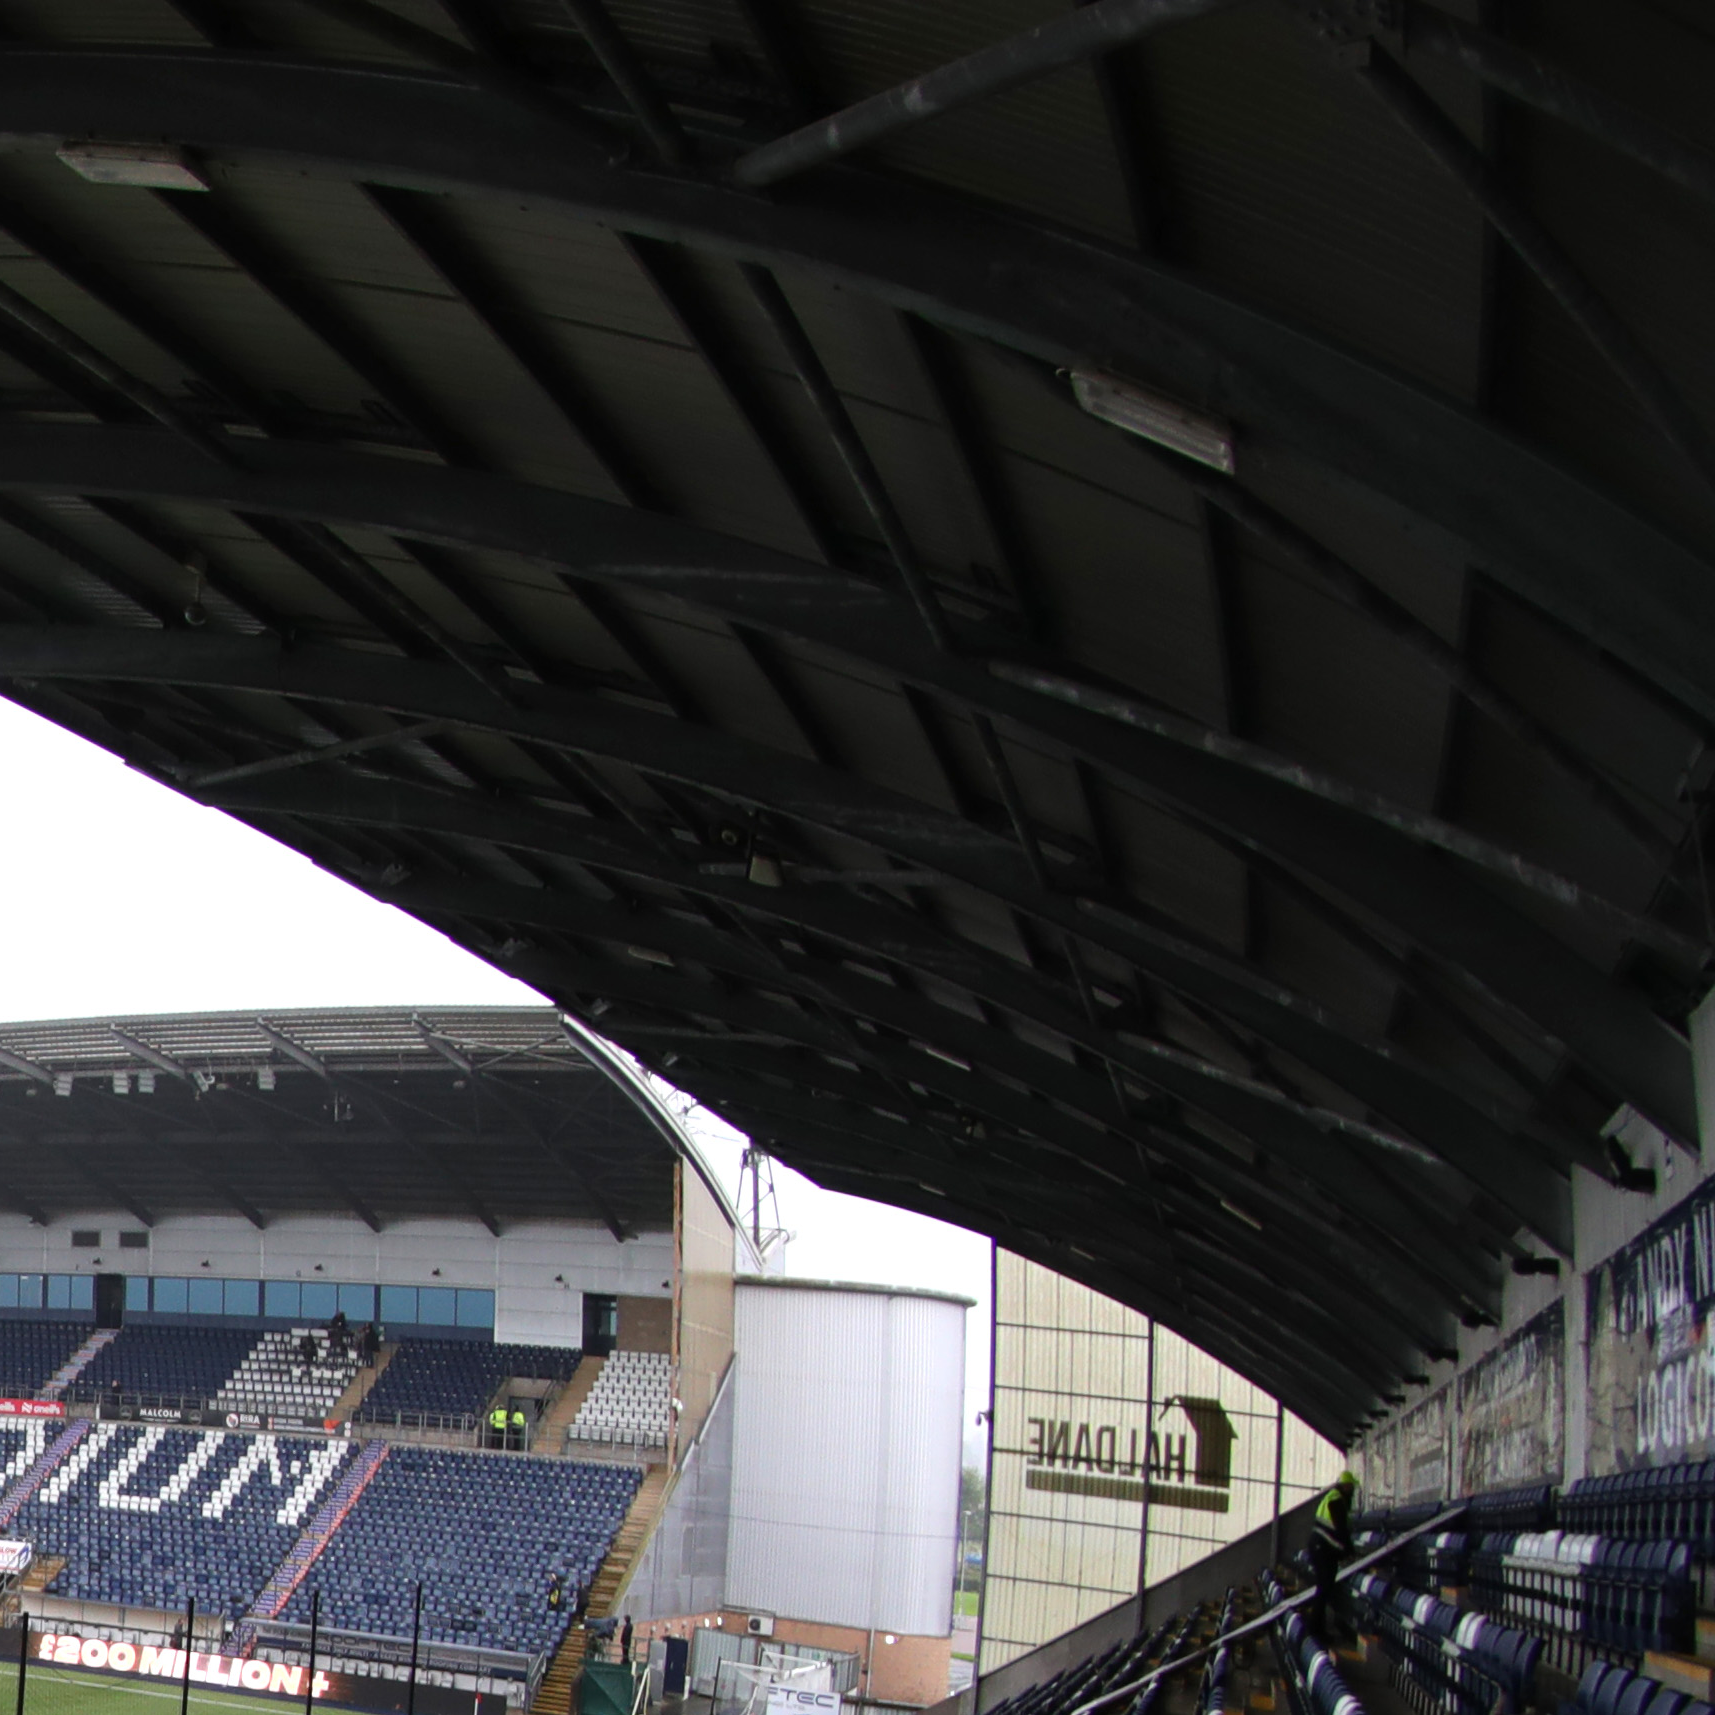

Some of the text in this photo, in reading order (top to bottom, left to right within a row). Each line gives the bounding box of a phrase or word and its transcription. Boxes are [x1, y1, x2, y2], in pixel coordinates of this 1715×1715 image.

[139, 1408, 182, 1419] MALCOLM
[38, 1633, 136, 1672] £200
[138, 1646, 303, 1696] MILLION
